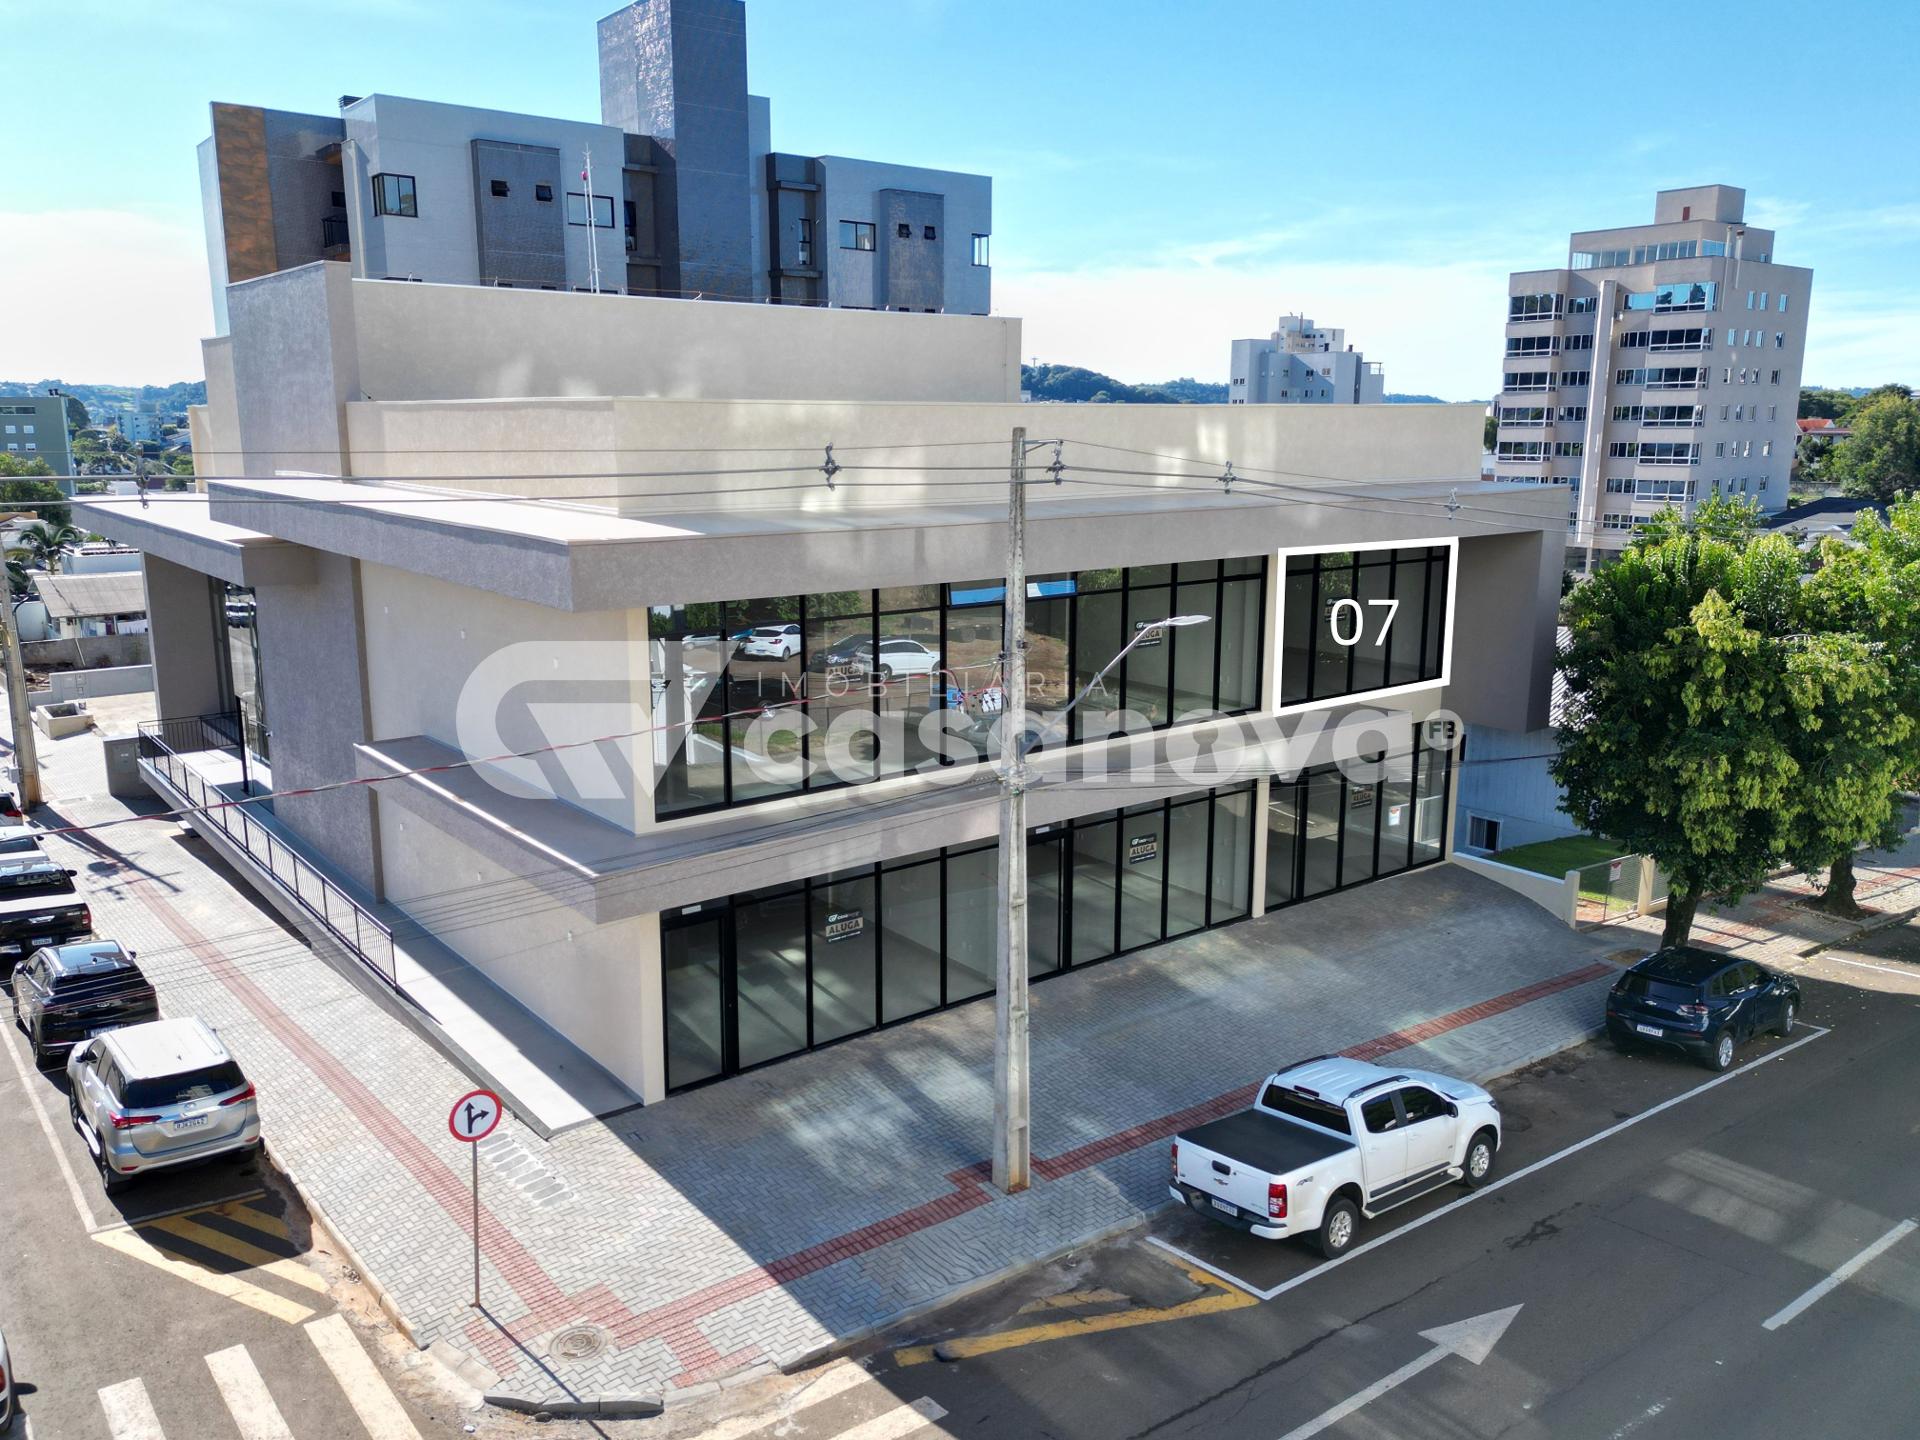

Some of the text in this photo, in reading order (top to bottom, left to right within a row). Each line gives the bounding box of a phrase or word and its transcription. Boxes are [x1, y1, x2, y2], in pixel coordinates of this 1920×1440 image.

[1137, 630, 1160, 639] UGA
[1131, 844, 1155, 856] ALUGA
[828, 919, 861, 936] ALUGA
